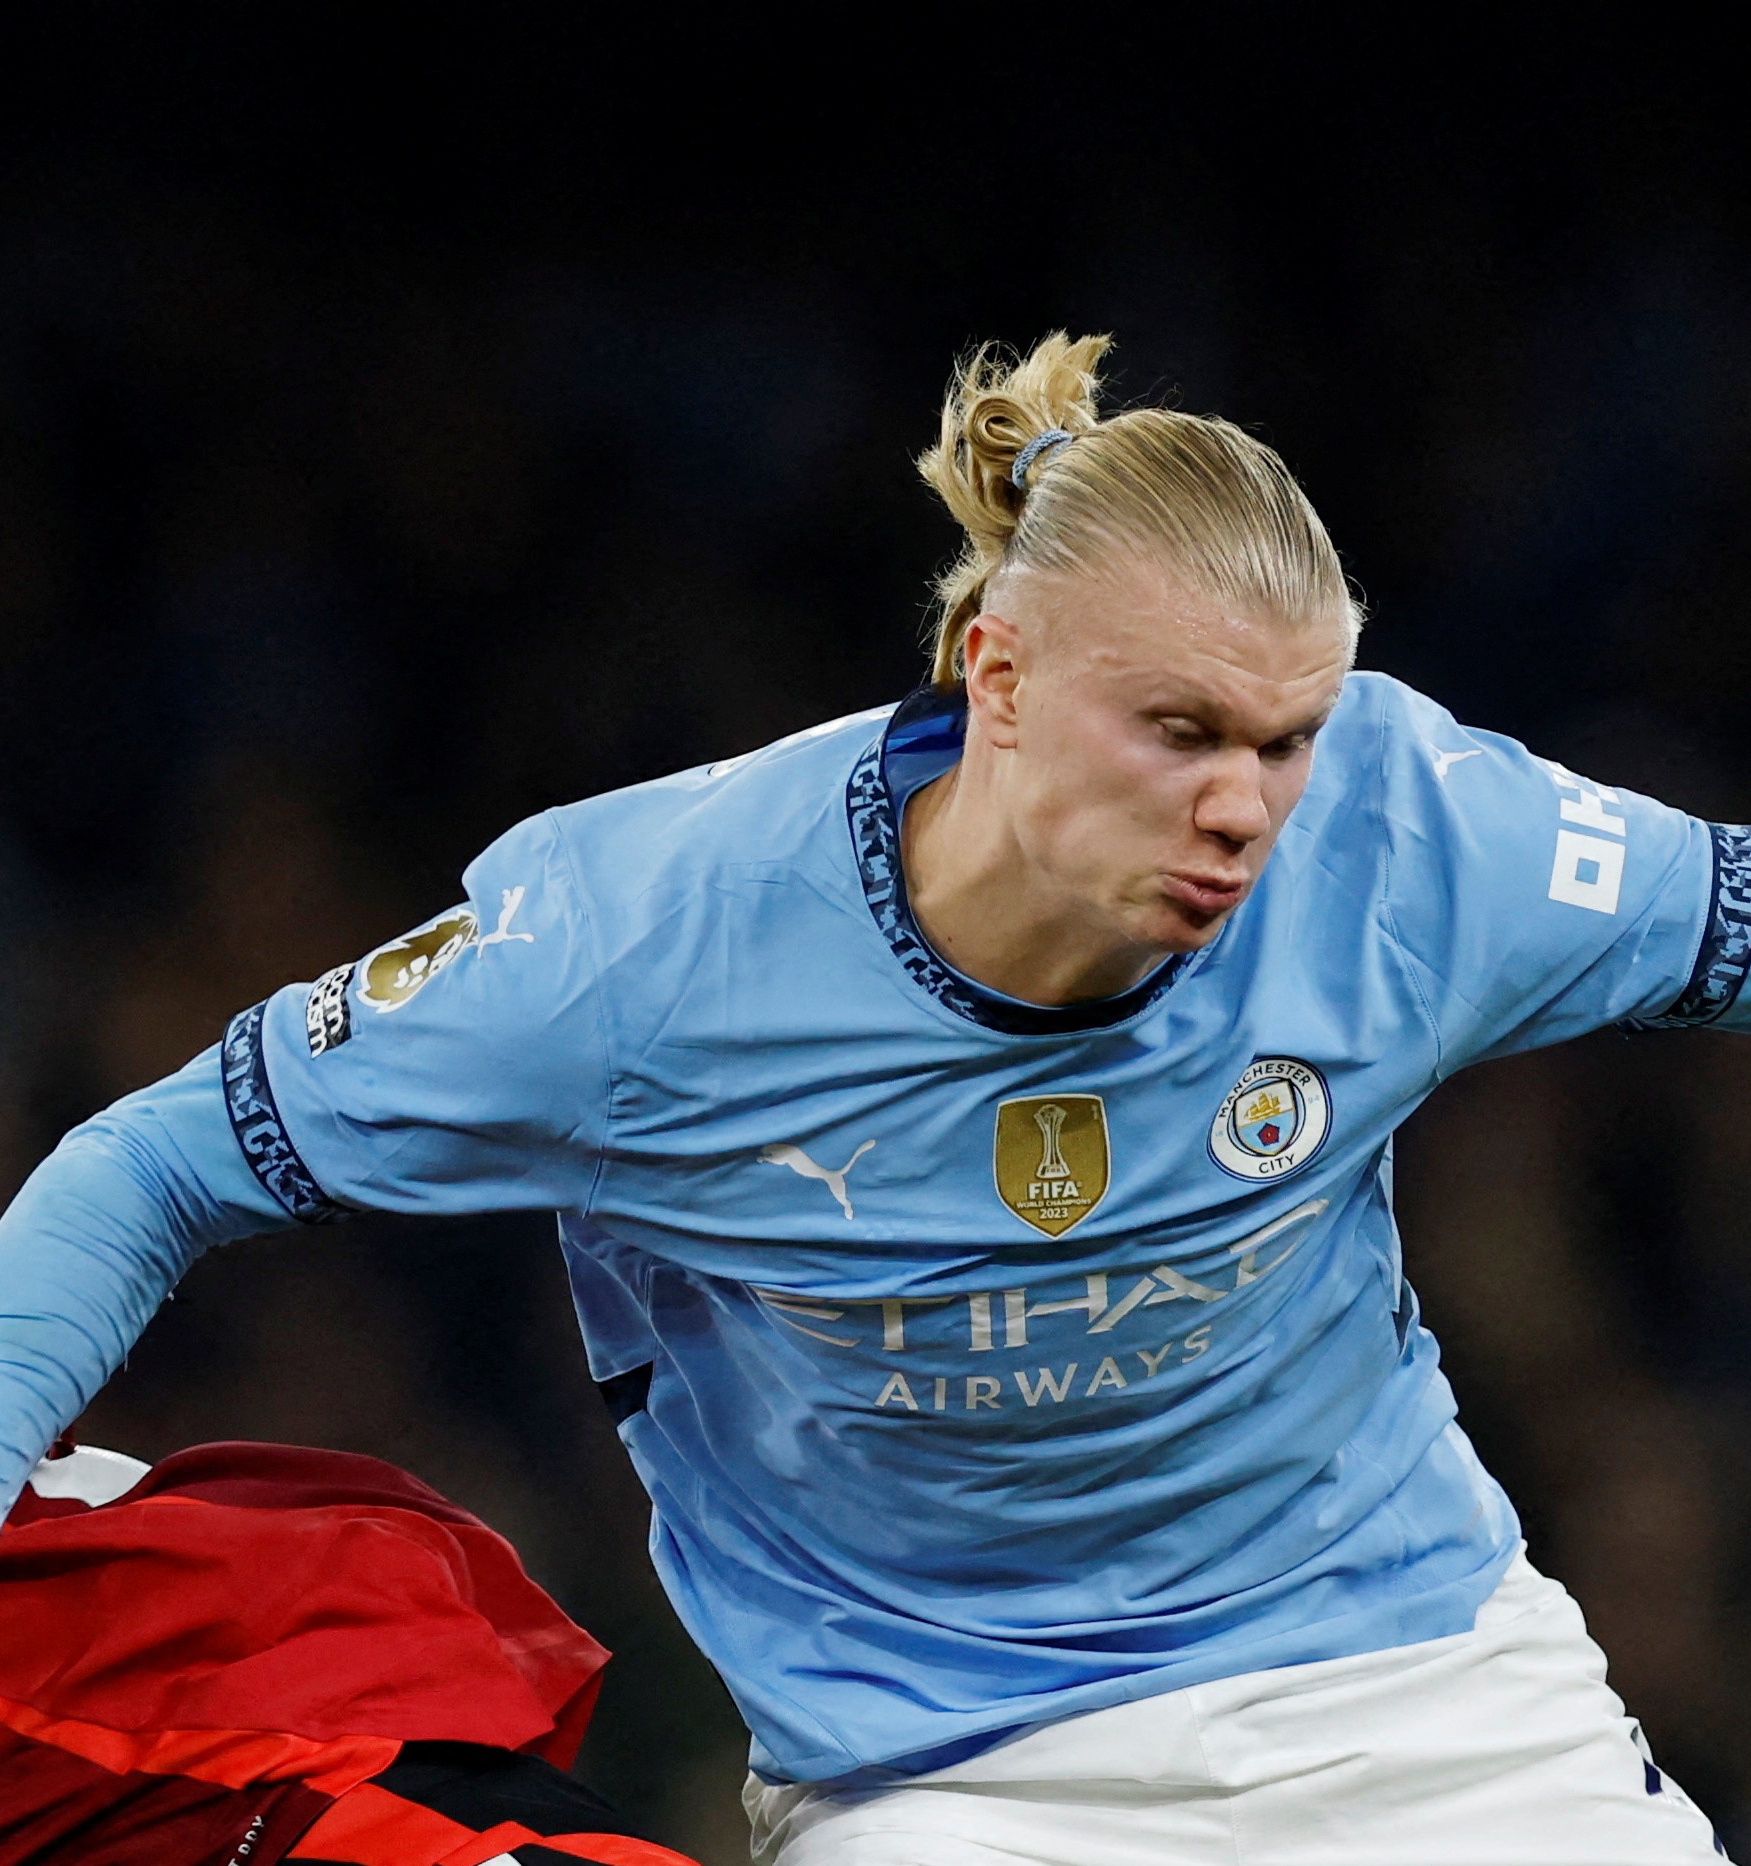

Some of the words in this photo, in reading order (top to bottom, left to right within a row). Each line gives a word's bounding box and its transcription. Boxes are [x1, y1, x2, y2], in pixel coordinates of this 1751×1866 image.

[1218, 1063, 1311, 1118] MANCHESTER
[1258, 1153, 1295, 1174] CITY
[1027, 1180, 1079, 1200] FIFA
[1016, 1200, 1045, 1209] WORLD
[1045, 1198, 1092, 1208] CHAMPIONS
[1039, 1207, 1069, 1219] 2023
[751, 1199, 1330, 1352] ETIHAD
[874, 1324, 1211, 1411] AIRWAYS
